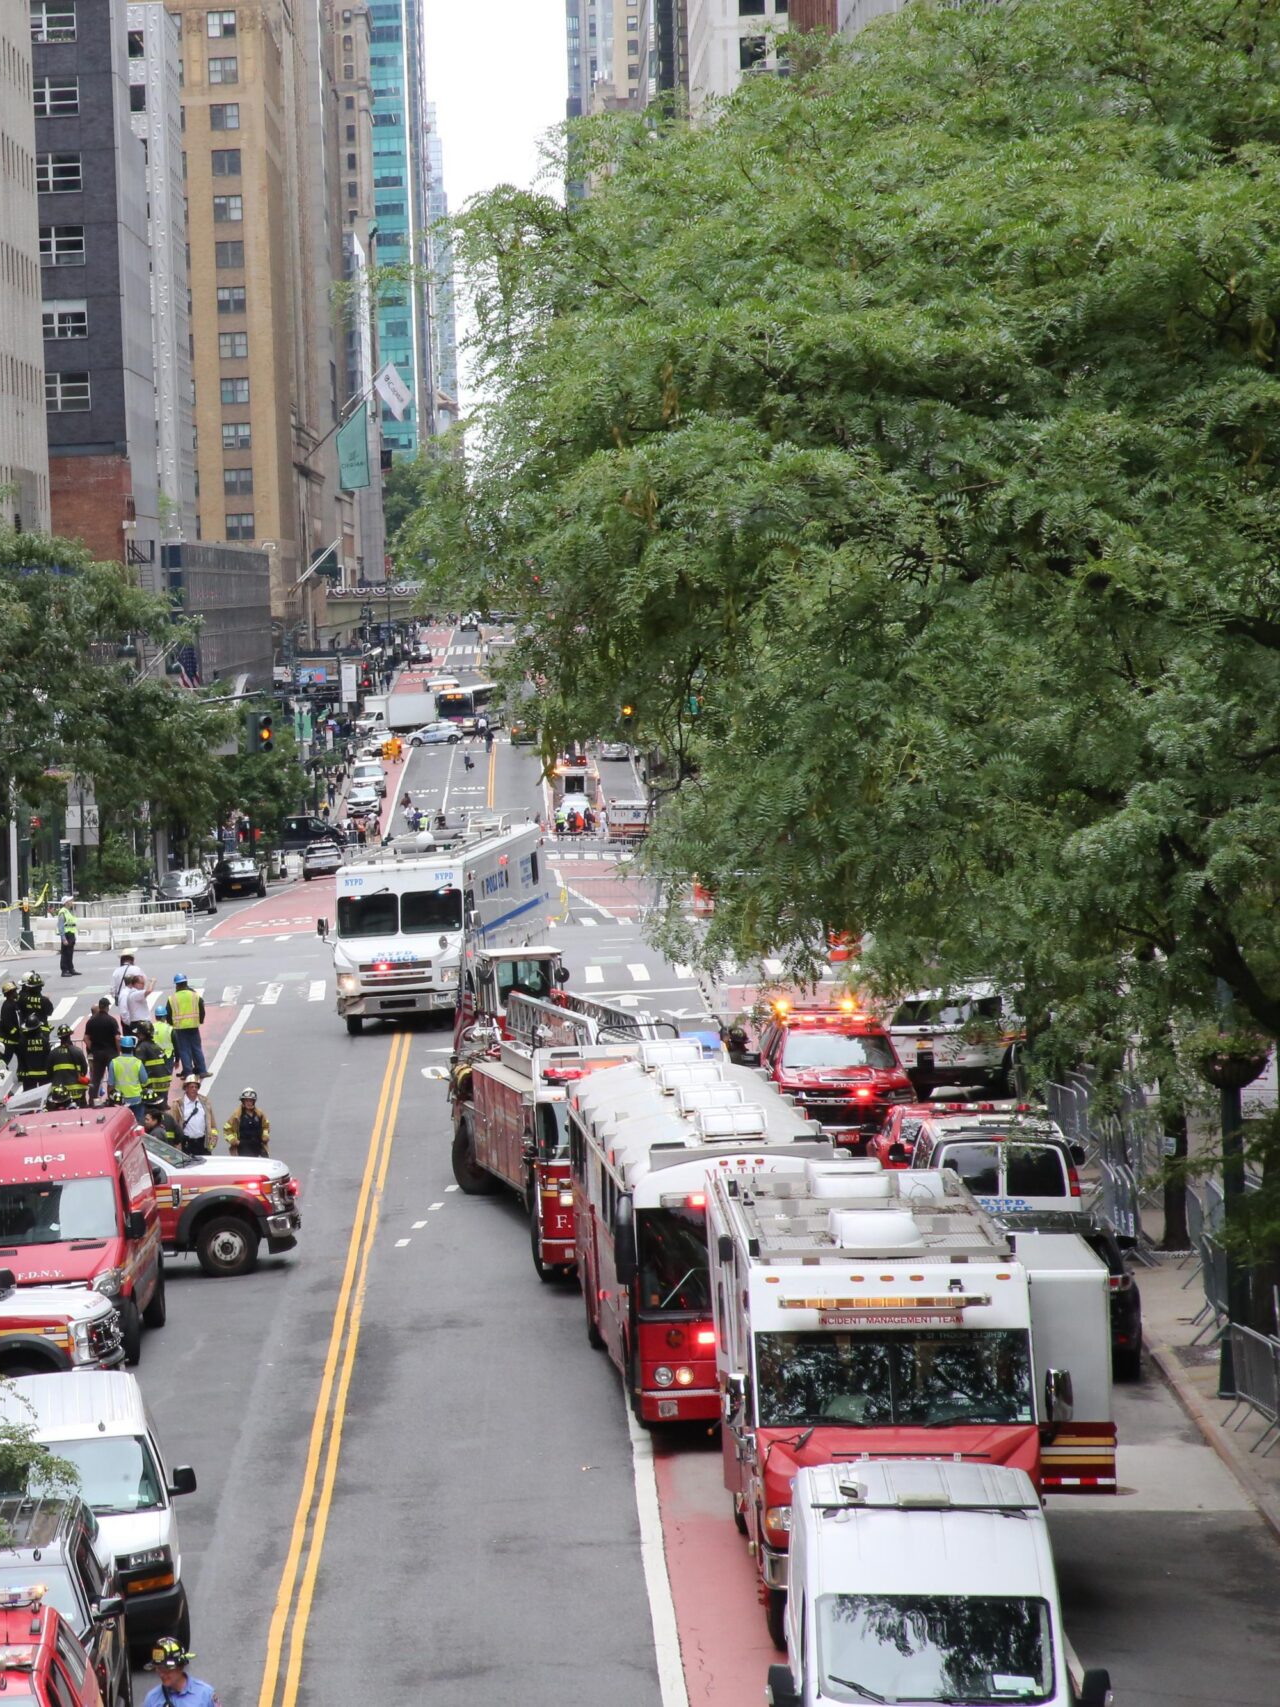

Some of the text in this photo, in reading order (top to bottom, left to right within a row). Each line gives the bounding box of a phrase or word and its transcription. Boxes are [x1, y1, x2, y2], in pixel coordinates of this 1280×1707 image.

[435, 872, 454, 880] NYPD
[344, 878, 363, 886] NYPD
[24, 1153, 66, 1165] RAC-3
[983, 1205, 1033, 1213] OLICE
[18, 1269, 65, 1281] F.D.N.Y.
[818, 1315, 964, 1325] INCIDENT MANAGEMENT TEAM
